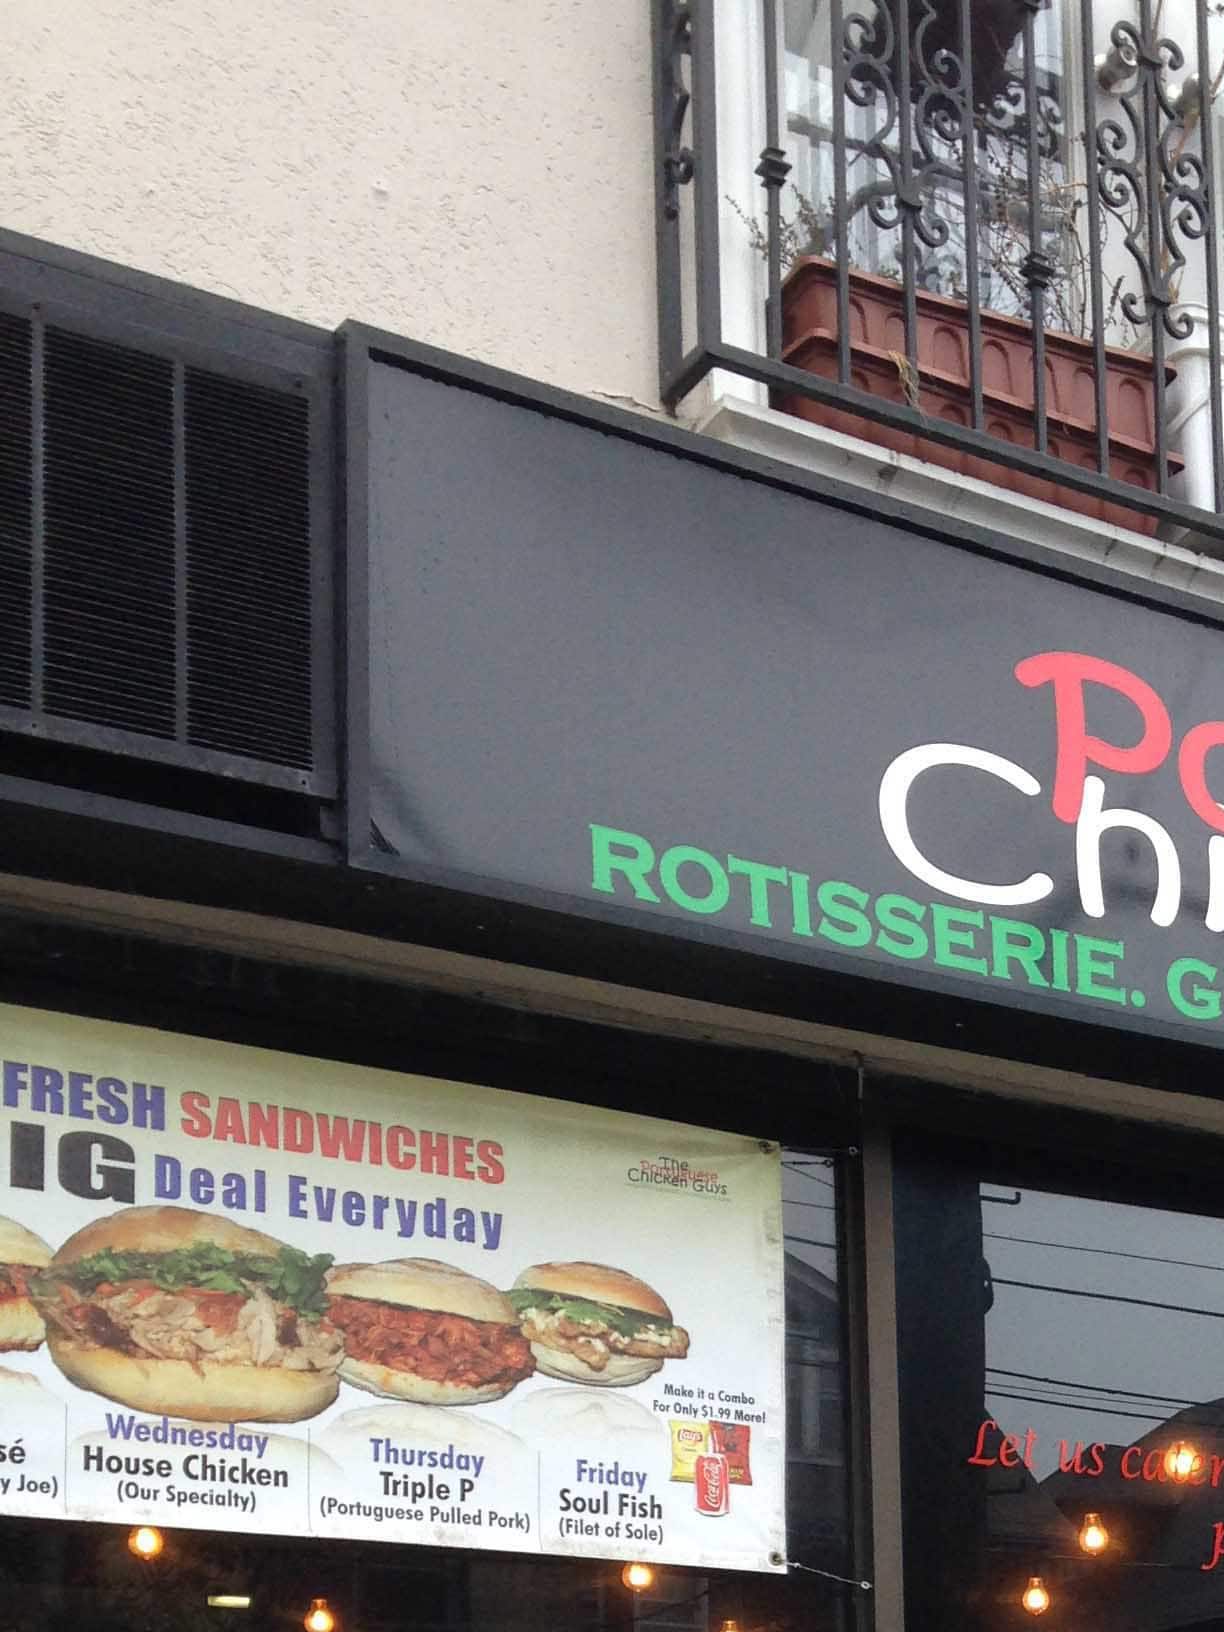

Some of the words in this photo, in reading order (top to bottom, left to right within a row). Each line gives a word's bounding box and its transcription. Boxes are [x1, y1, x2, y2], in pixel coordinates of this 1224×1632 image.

[589, 823, 1147, 1007] ROTISSERIE.
[2, 1060, 166, 1131] FRESH
[180, 1091, 505, 1184] SANDWICHES
[154, 1153, 266, 1213] Deal
[288, 1174, 504, 1250] Everyday
[692, 1179, 728, 1195] Guys
[663, 1383, 694, 1398] Make
[697, 1388, 704, 1399] it
[708, 1391, 714, 1400] a
[718, 1390, 755, 1405] Combo
[653, 1400, 670, 1412] For
[673, 1402, 698, 1418] Only
[701, 1405, 730, 1418] $1.99
[734, 1409, 766, 1424] More!
[105, 1413, 268, 1458] Wednesday
[967, 1419, 1039, 1471] Let
[1058, 1438, 1105, 1477] us
[83, 1444, 173, 1478] House
[182, 1454, 289, 1488] Chicken
[369, 1437, 485, 1478] Thursday
[16, 1473, 58, 1499] Joe)
[379, 1471, 451, 1504] Triple
[459, 1478, 475, 1502] P
[576, 1459, 648, 1493] Friday
[117, 1479, 161, 1503] (Our
[166, 1485, 256, 1513] Specialty)
[559, 1488, 608, 1515] Soul
[618, 1493, 663, 1519] Fish
[320, 1495, 424, 1522] (Portuguese
[430, 1506, 482, 1526] Pulled
[488, 1511, 531, 1534] Pork)
[559, 1517, 600, 1538] (Filet
[604, 1521, 621, 1538] of
[625, 1523, 664, 1545] Sole)
